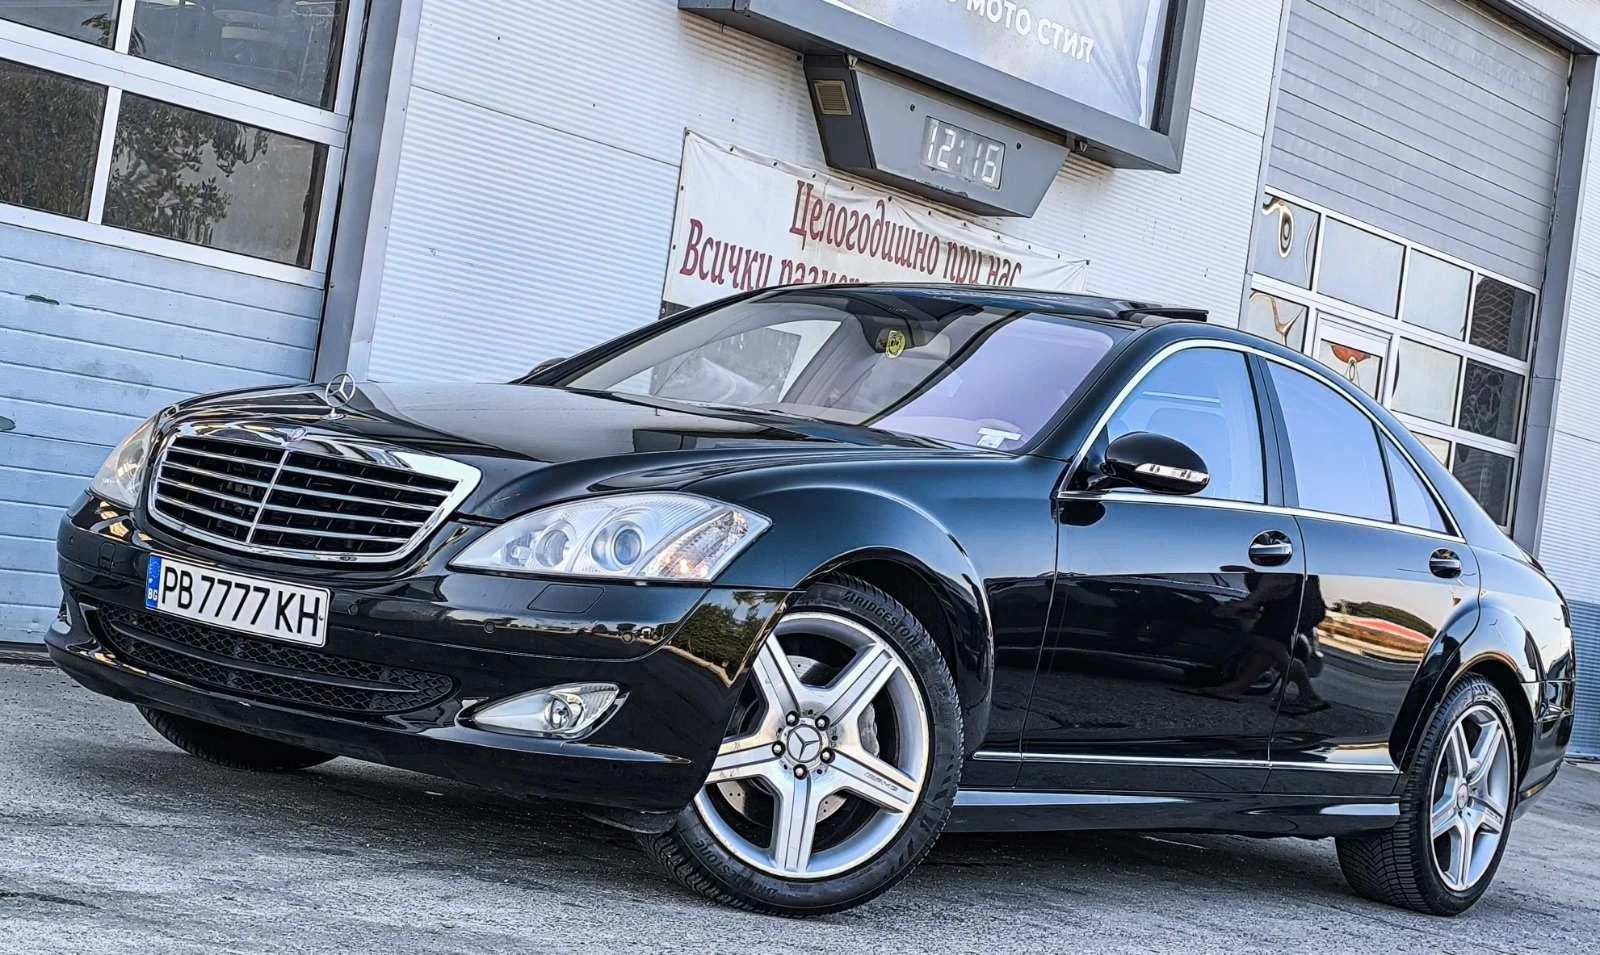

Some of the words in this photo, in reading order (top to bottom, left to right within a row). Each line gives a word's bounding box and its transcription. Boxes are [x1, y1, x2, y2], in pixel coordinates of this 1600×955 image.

[966, 0, 1032, 36] МОТО
[1037, 18, 1095, 64] СТИЛ
[927, 126, 1000, 184] 12:16
[679, 218, 773, 291] Всички
[789, 179, 940, 276] Целогодишно
[943, 240, 983, 285] при
[987, 255, 1023, 286] нас
[147, 587, 159, 601] BG
[161, 566, 193, 610] PB
[198, 574, 271, 626] 7777
[274, 590, 321, 637] KH
